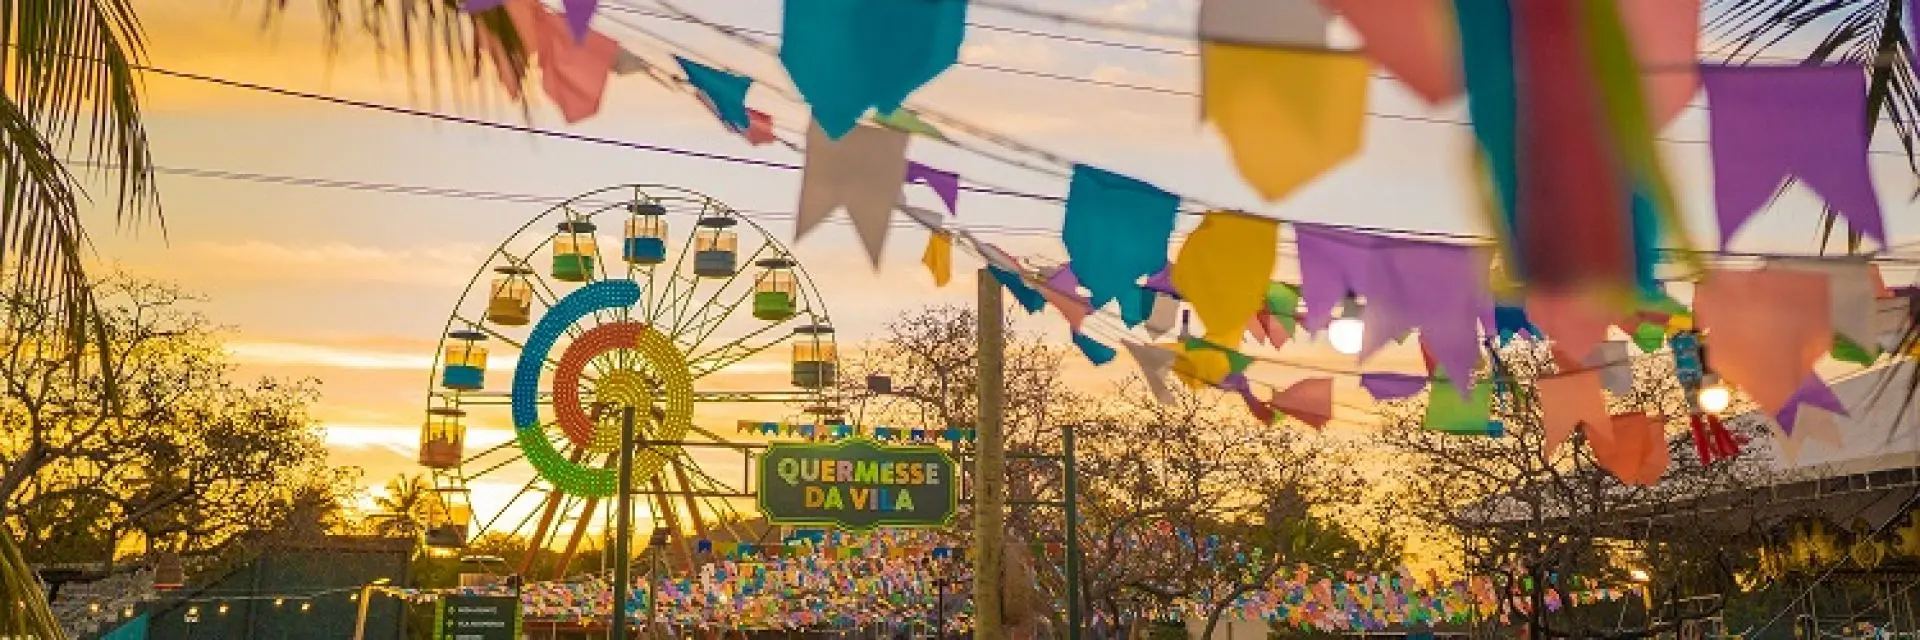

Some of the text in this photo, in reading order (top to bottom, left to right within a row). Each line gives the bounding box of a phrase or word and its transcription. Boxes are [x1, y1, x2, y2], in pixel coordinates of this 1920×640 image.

[777, 457, 940, 486] QUERMESSE
[805, 486, 915, 512] DA VILA
